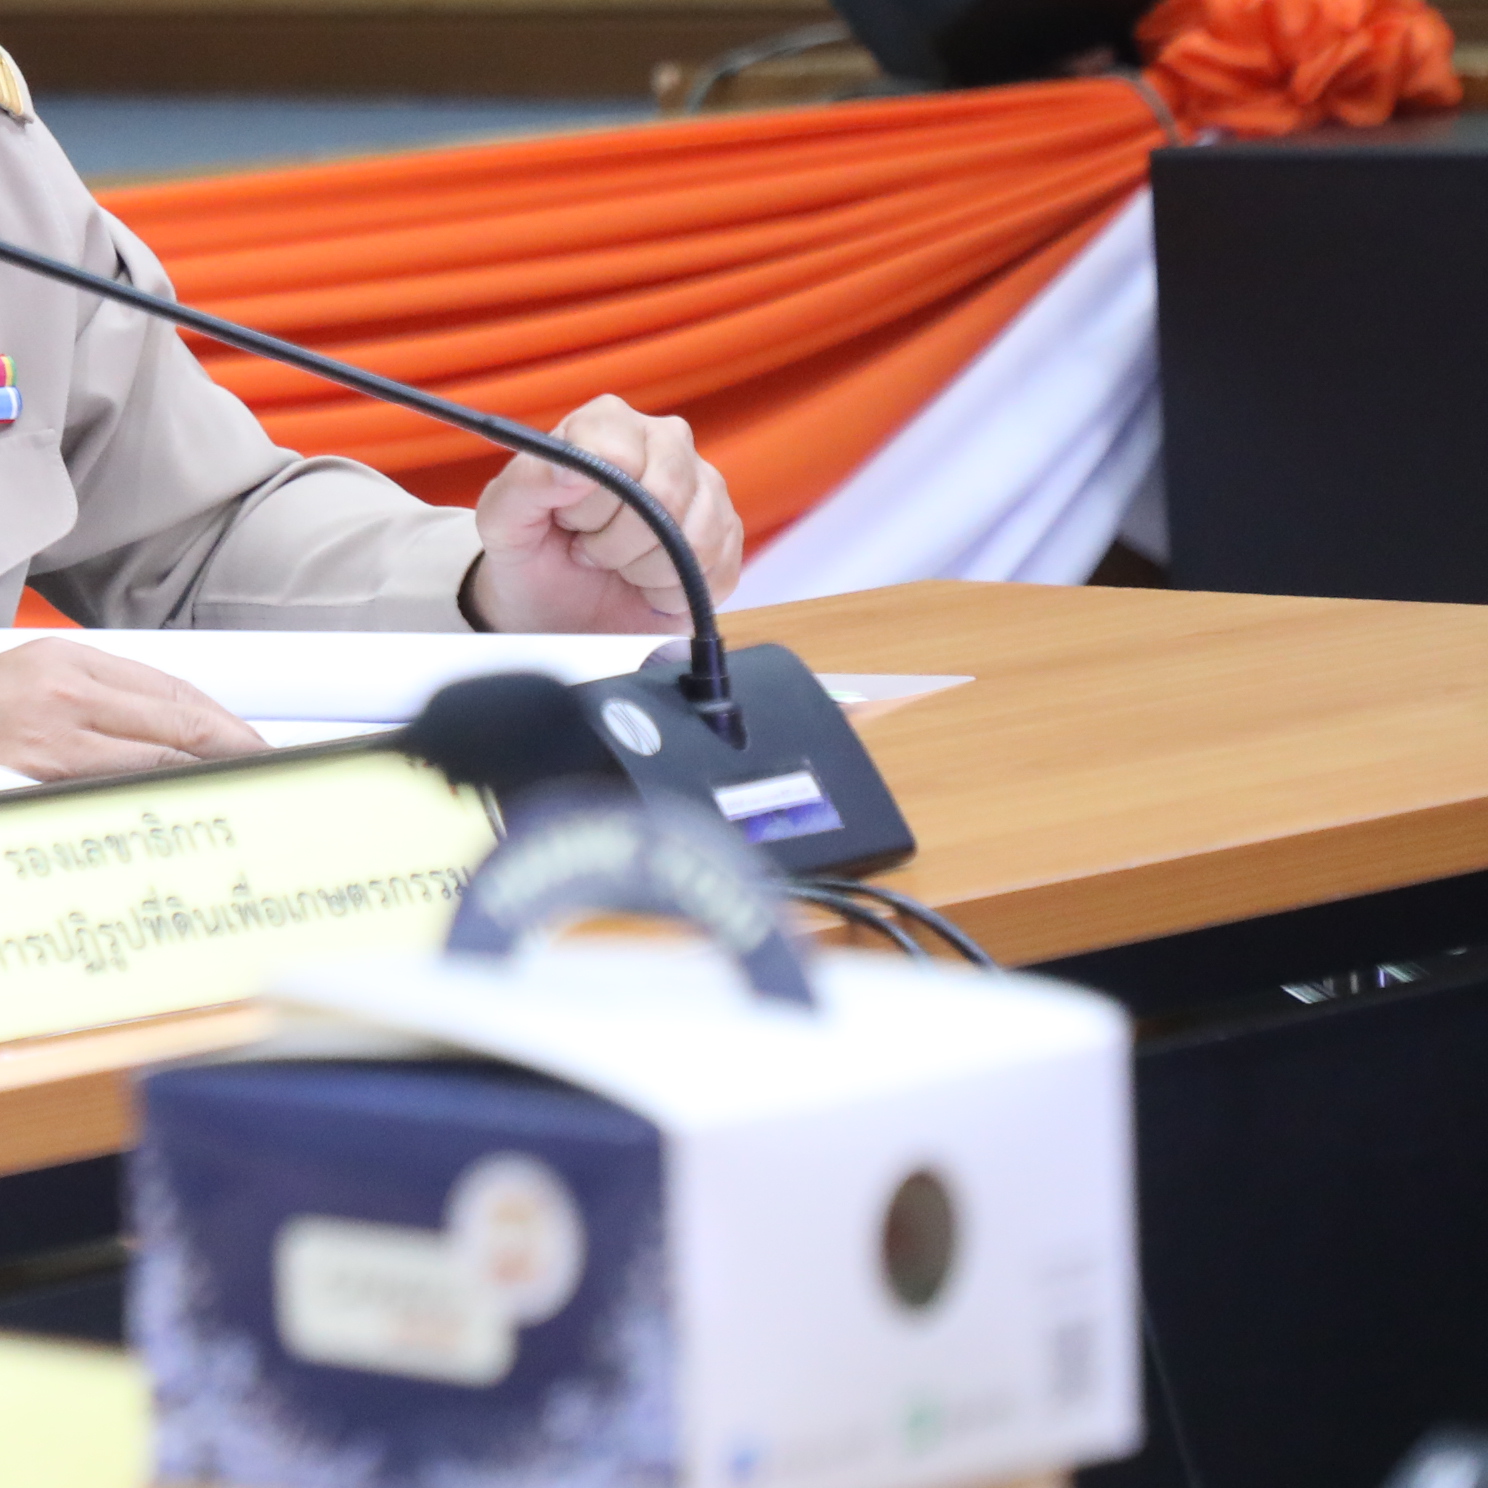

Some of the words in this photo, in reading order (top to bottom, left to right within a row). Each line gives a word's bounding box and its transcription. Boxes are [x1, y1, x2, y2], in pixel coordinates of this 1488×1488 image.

[3, 811, 237, 880] รองเลขาธิการ
